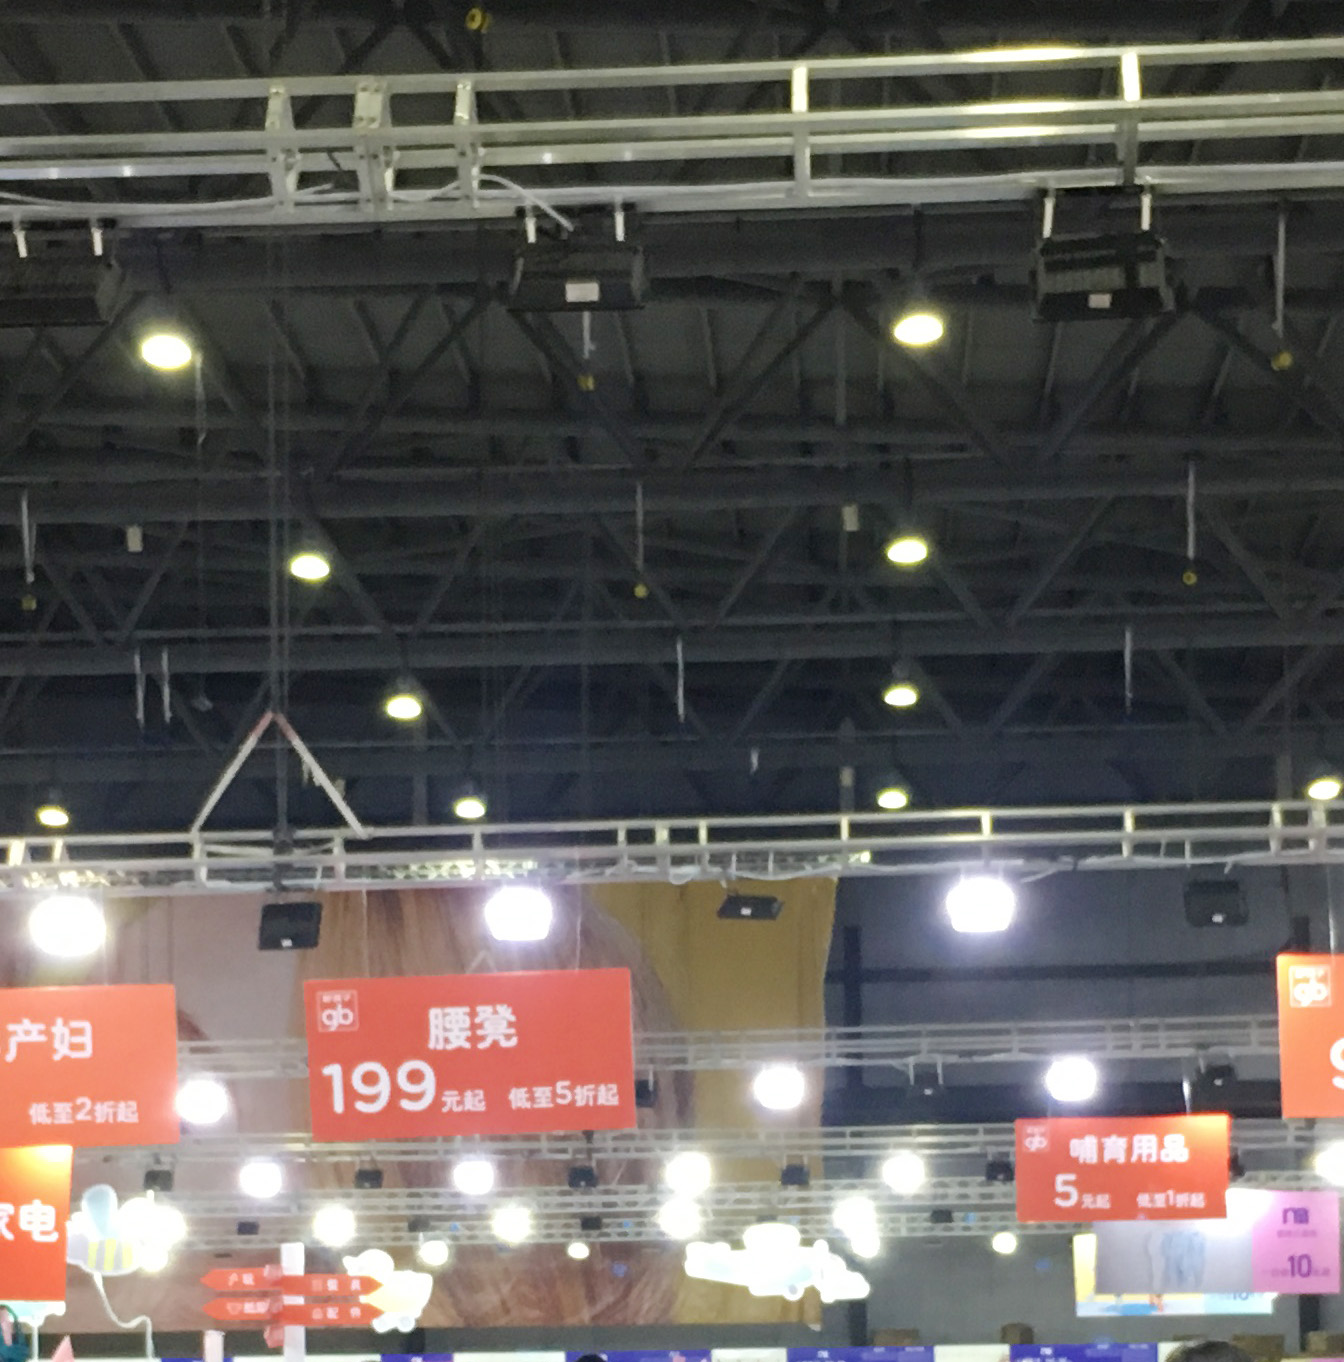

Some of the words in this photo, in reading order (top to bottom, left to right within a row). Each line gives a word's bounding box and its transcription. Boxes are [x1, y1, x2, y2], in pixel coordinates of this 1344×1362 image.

[322, 1003, 355, 1032] gb
[427, 1003, 519, 1052] 腰凳
[321, 1060, 487, 1114] 199元起
[508, 1083, 620, 1111] 低至5折起
[28, 1097, 140, 1126] 低至2折起
[1069, 1134, 1190, 1165] 哺育用品
[1054, 1174, 1111, 1210] 5元起
[1136, 1189, 1206, 1210] 低至1折起
